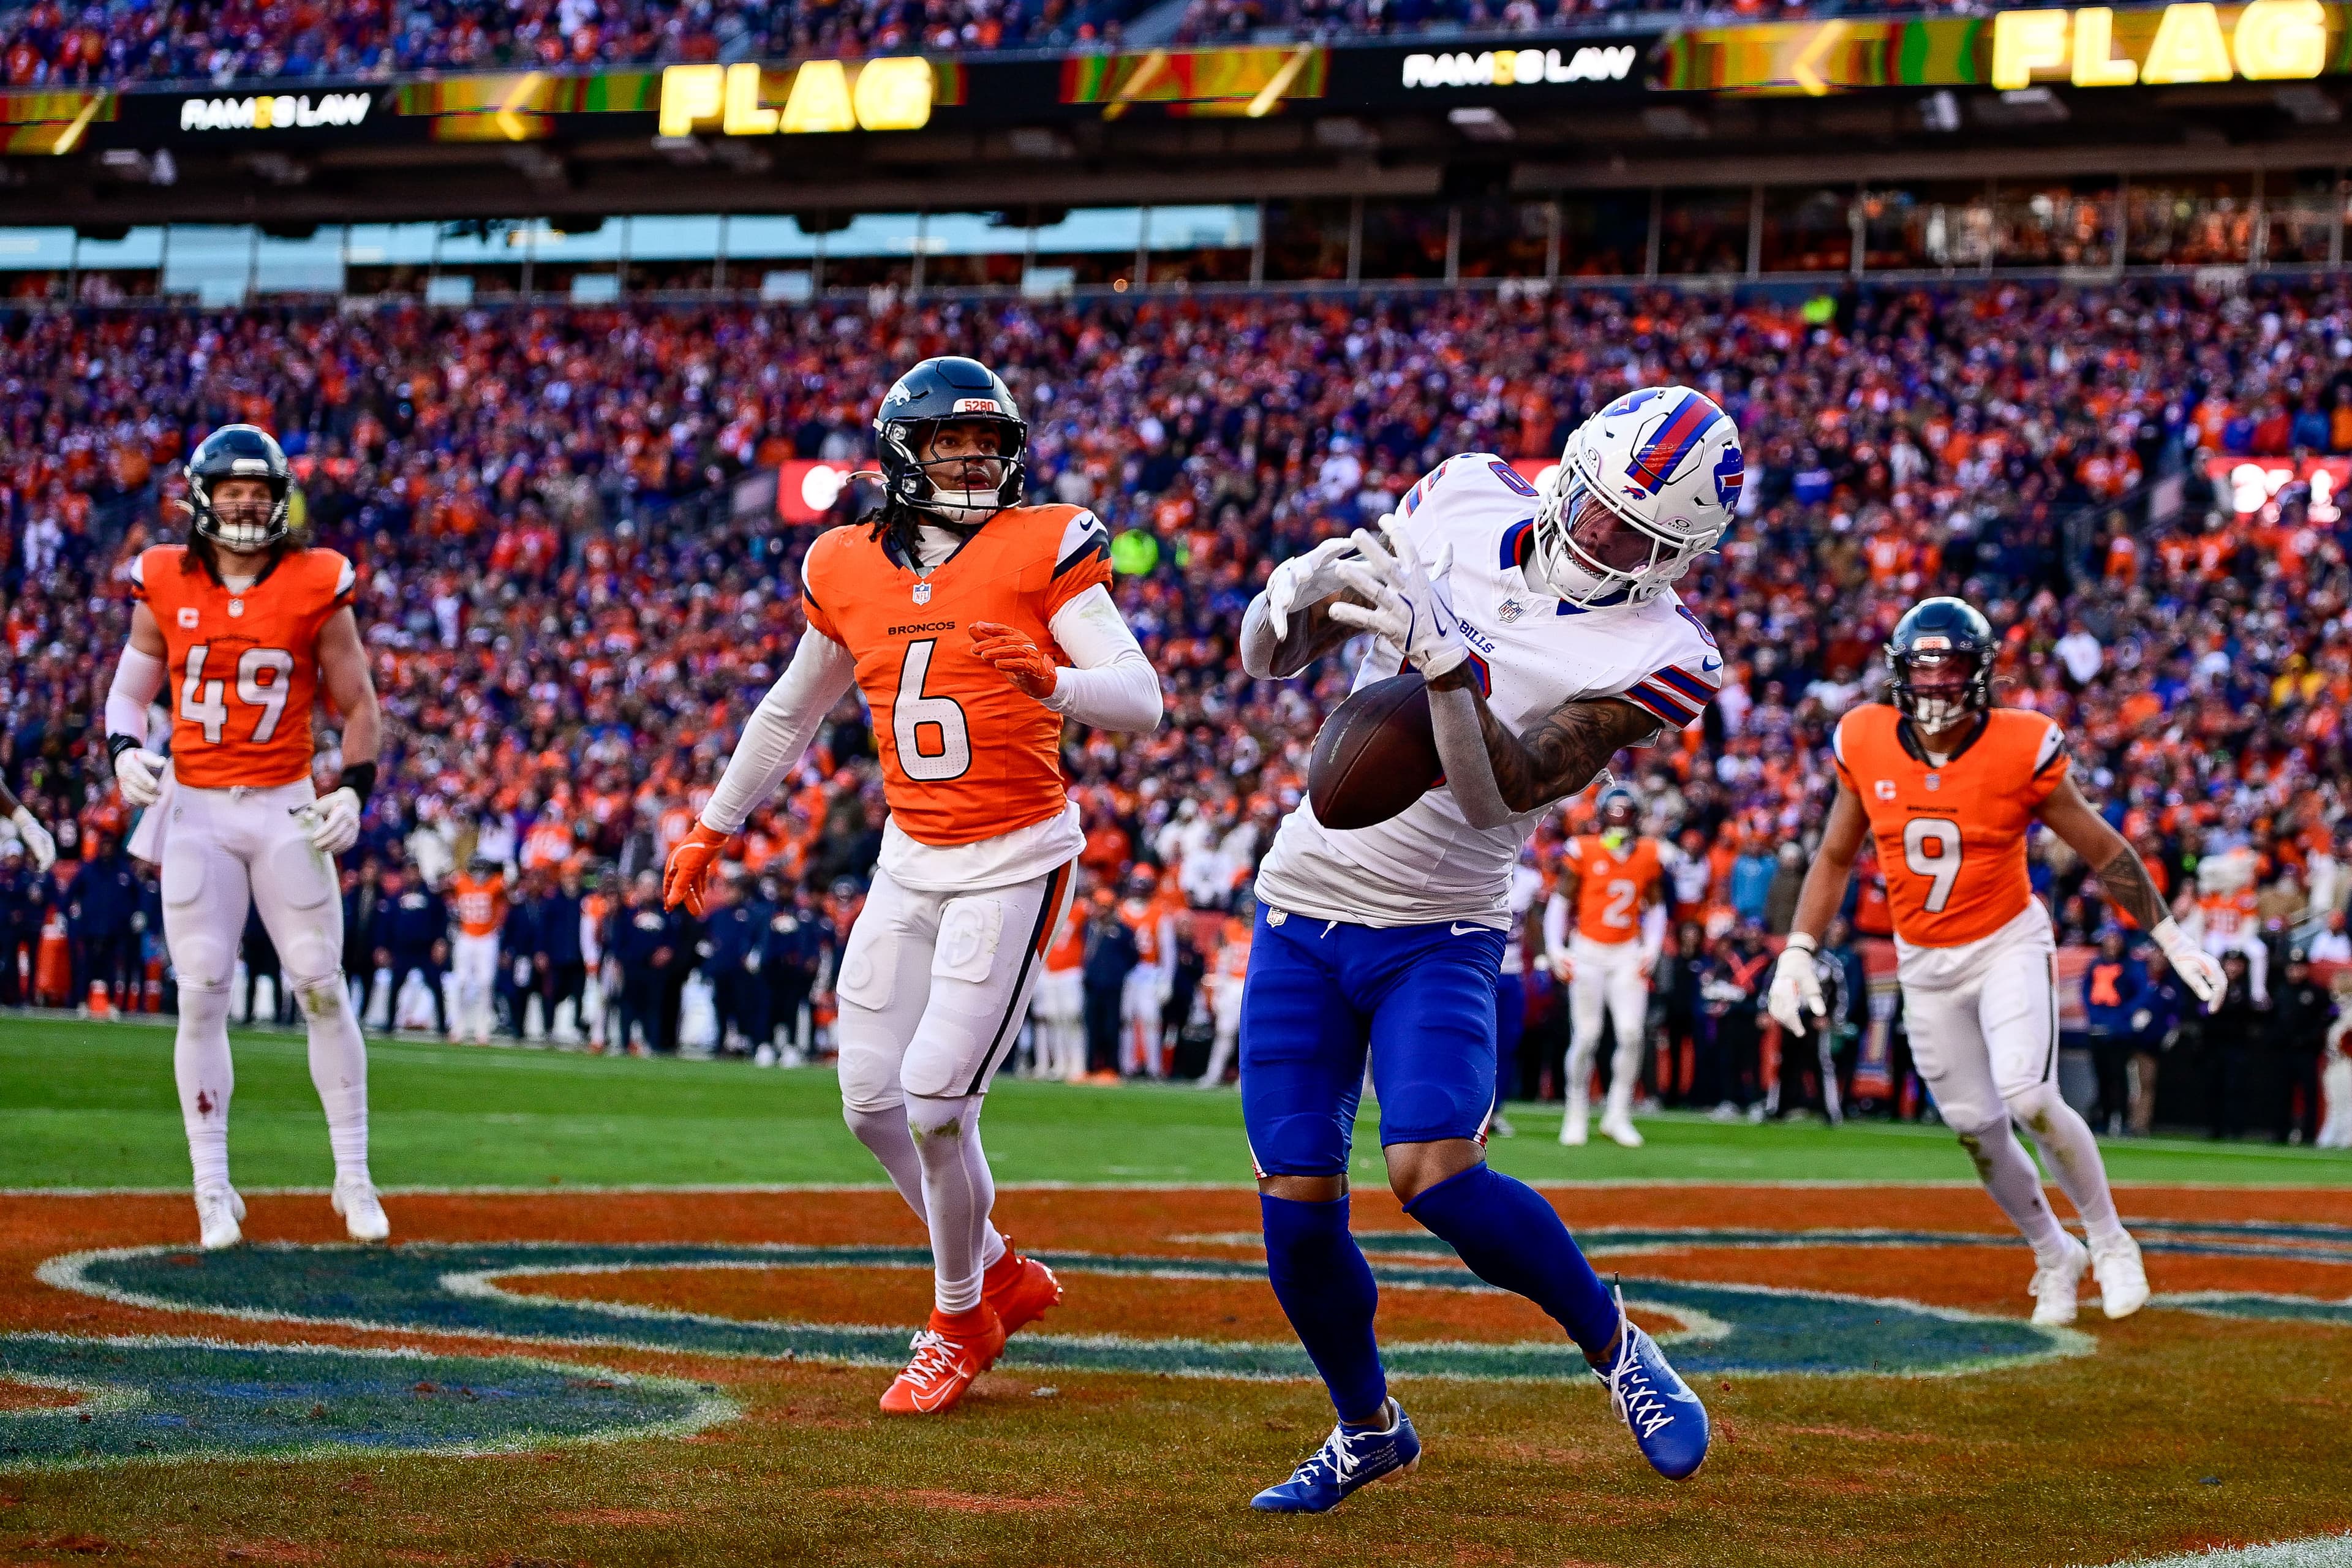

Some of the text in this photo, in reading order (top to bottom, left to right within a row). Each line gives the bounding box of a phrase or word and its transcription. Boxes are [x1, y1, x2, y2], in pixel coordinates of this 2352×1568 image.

[1992, 0, 2327, 89] FLAG
[1545, 45, 1637, 82] LAW
[658, 56, 932, 137] FLAG
[964, 401, 994, 412] 5280
[177, 607, 199, 628] C
[888, 621, 956, 635] BRONCOS
[1501, 604, 1516, 619] NFL
[1459, 619, 1495, 654] BILLS
[179, 645, 295, 744] 49
[892, 637, 973, 782] 6
[1874, 779, 1897, 801] C
[1903, 816, 1964, 914] 9
[1601, 878, 1637, 929] 2
